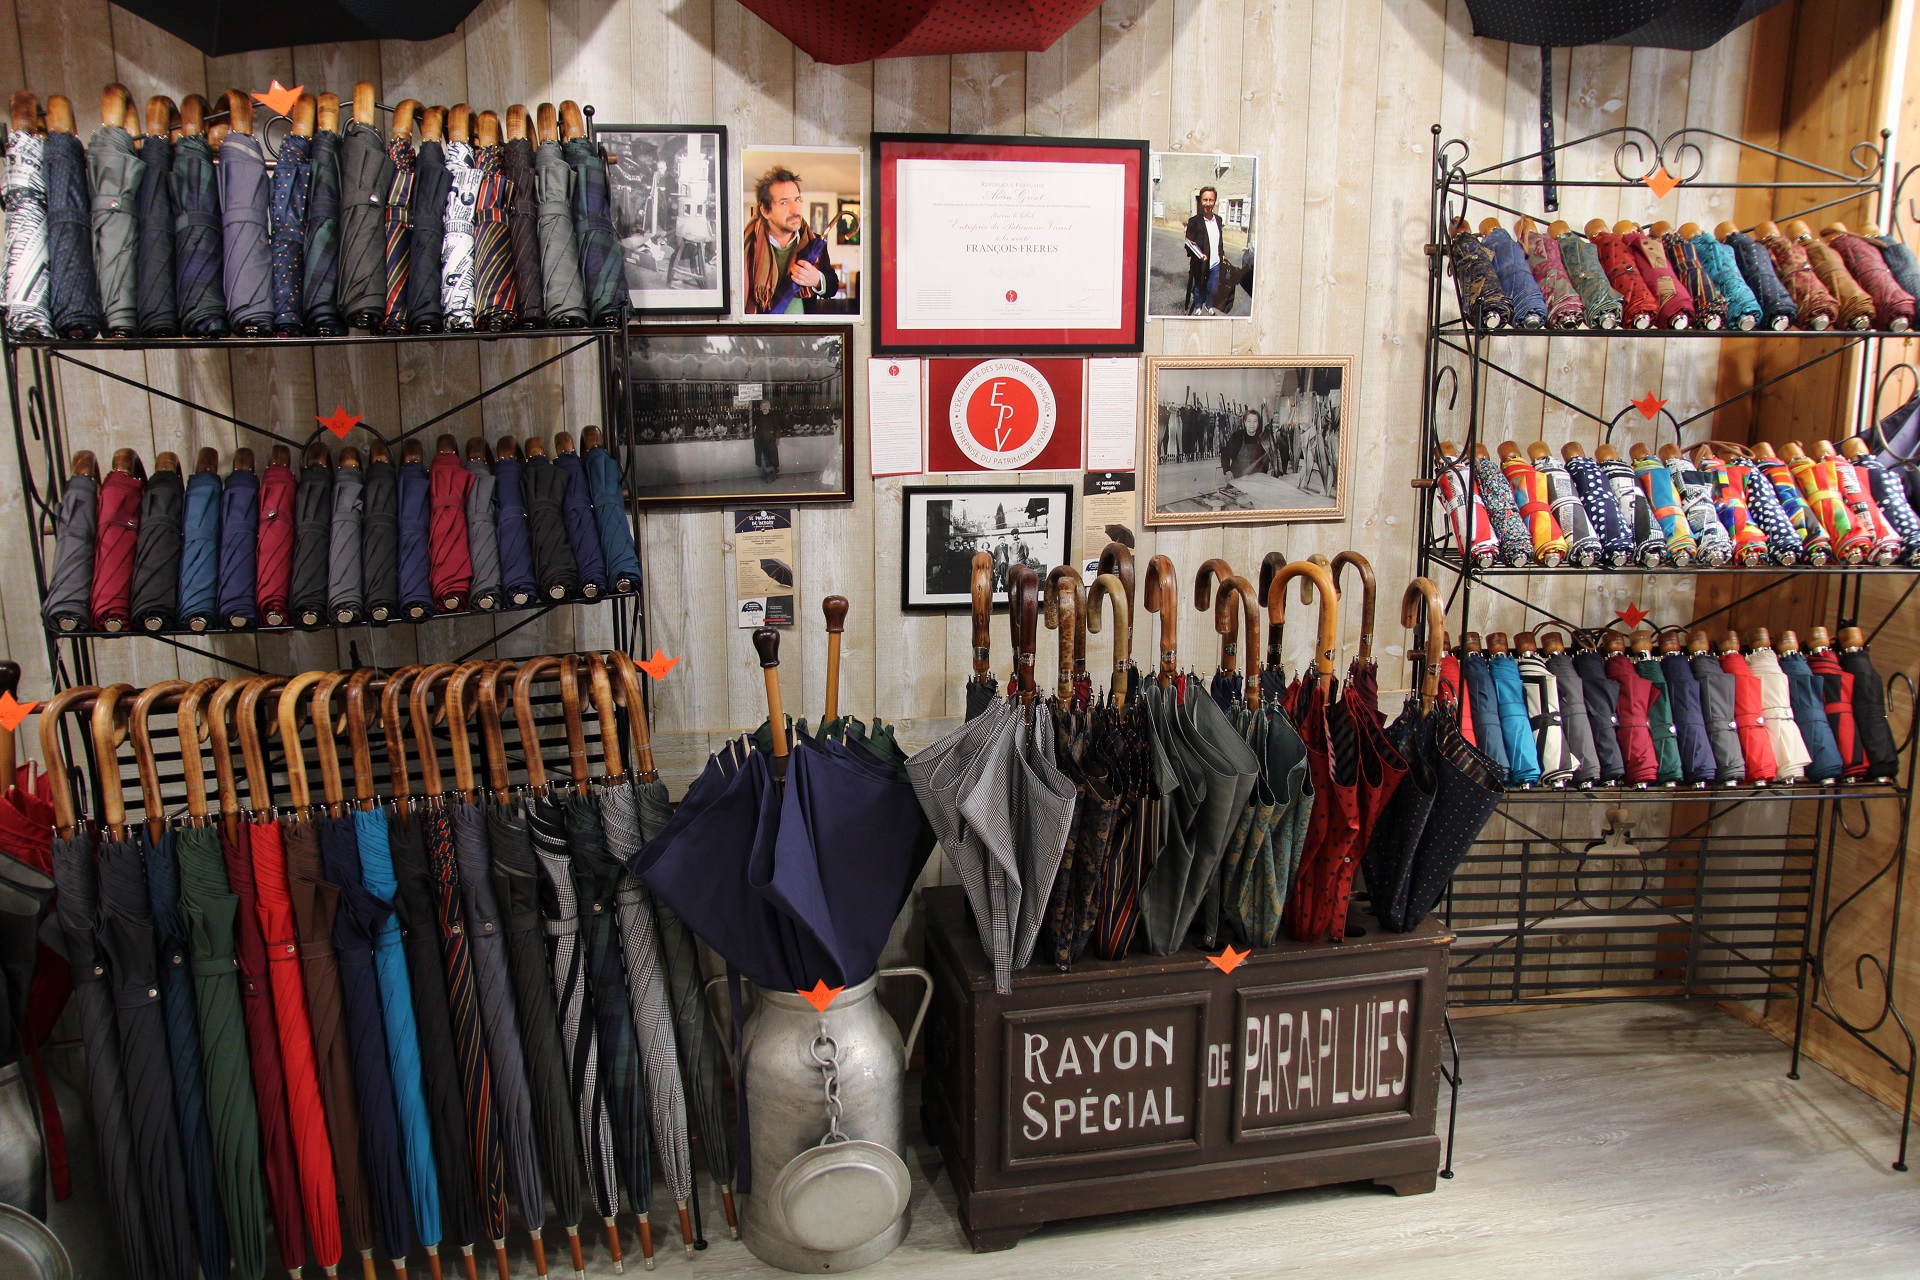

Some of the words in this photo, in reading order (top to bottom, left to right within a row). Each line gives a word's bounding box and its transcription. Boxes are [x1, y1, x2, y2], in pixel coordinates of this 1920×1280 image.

[966, 244, 1018, 254] FRANÇOIS
[1020, 244, 1059, 253] FRERES
[954, 370, 981, 412] L'EXCELLENCE
[981, 364, 994, 374] DES
[994, 363, 1037, 382] SAVOIR-FAIRE
[1036, 380, 1051, 411] FRANÇAIS
[954, 422, 980, 458] ENTREPRISE
[980, 454, 992, 464] DU
[993, 445, 1036, 465] PATRIMOINE
[1034, 421, 1050, 446] VIVANT
[1022, 1025, 1174, 1085] RAYON
[1207, 1042, 1232, 1088] DE
[1242, 998, 1409, 1117] PARAPLUIES
[1021, 1086, 1185, 1141] SPÉCIAL
